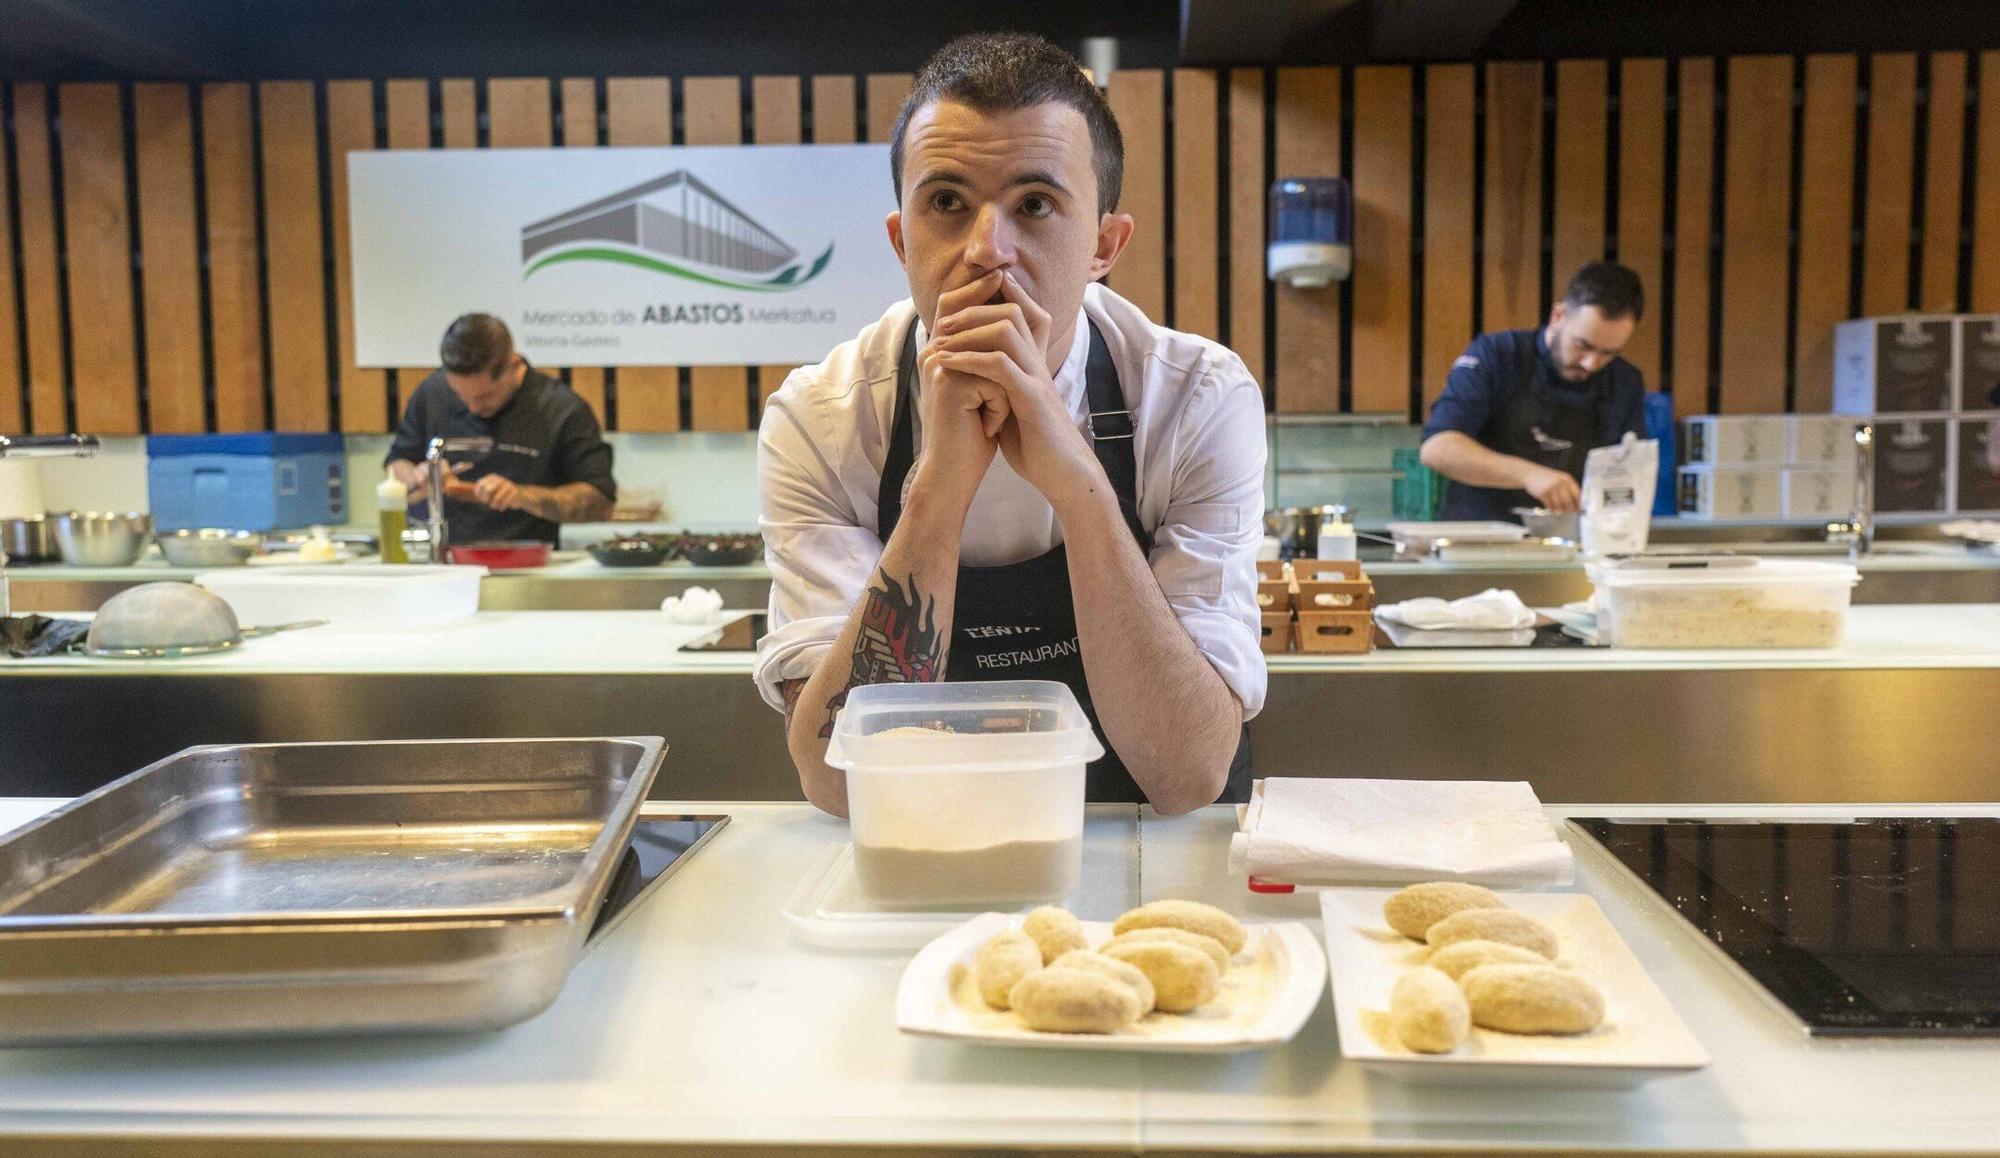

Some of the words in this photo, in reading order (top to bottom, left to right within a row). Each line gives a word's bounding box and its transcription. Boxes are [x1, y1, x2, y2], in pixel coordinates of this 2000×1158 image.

[522, 308, 607, 326] Mercado
[612, 308, 637, 326] de
[642, 303, 744, 325] ABASTOS
[749, 306, 837, 325] Merkatua
